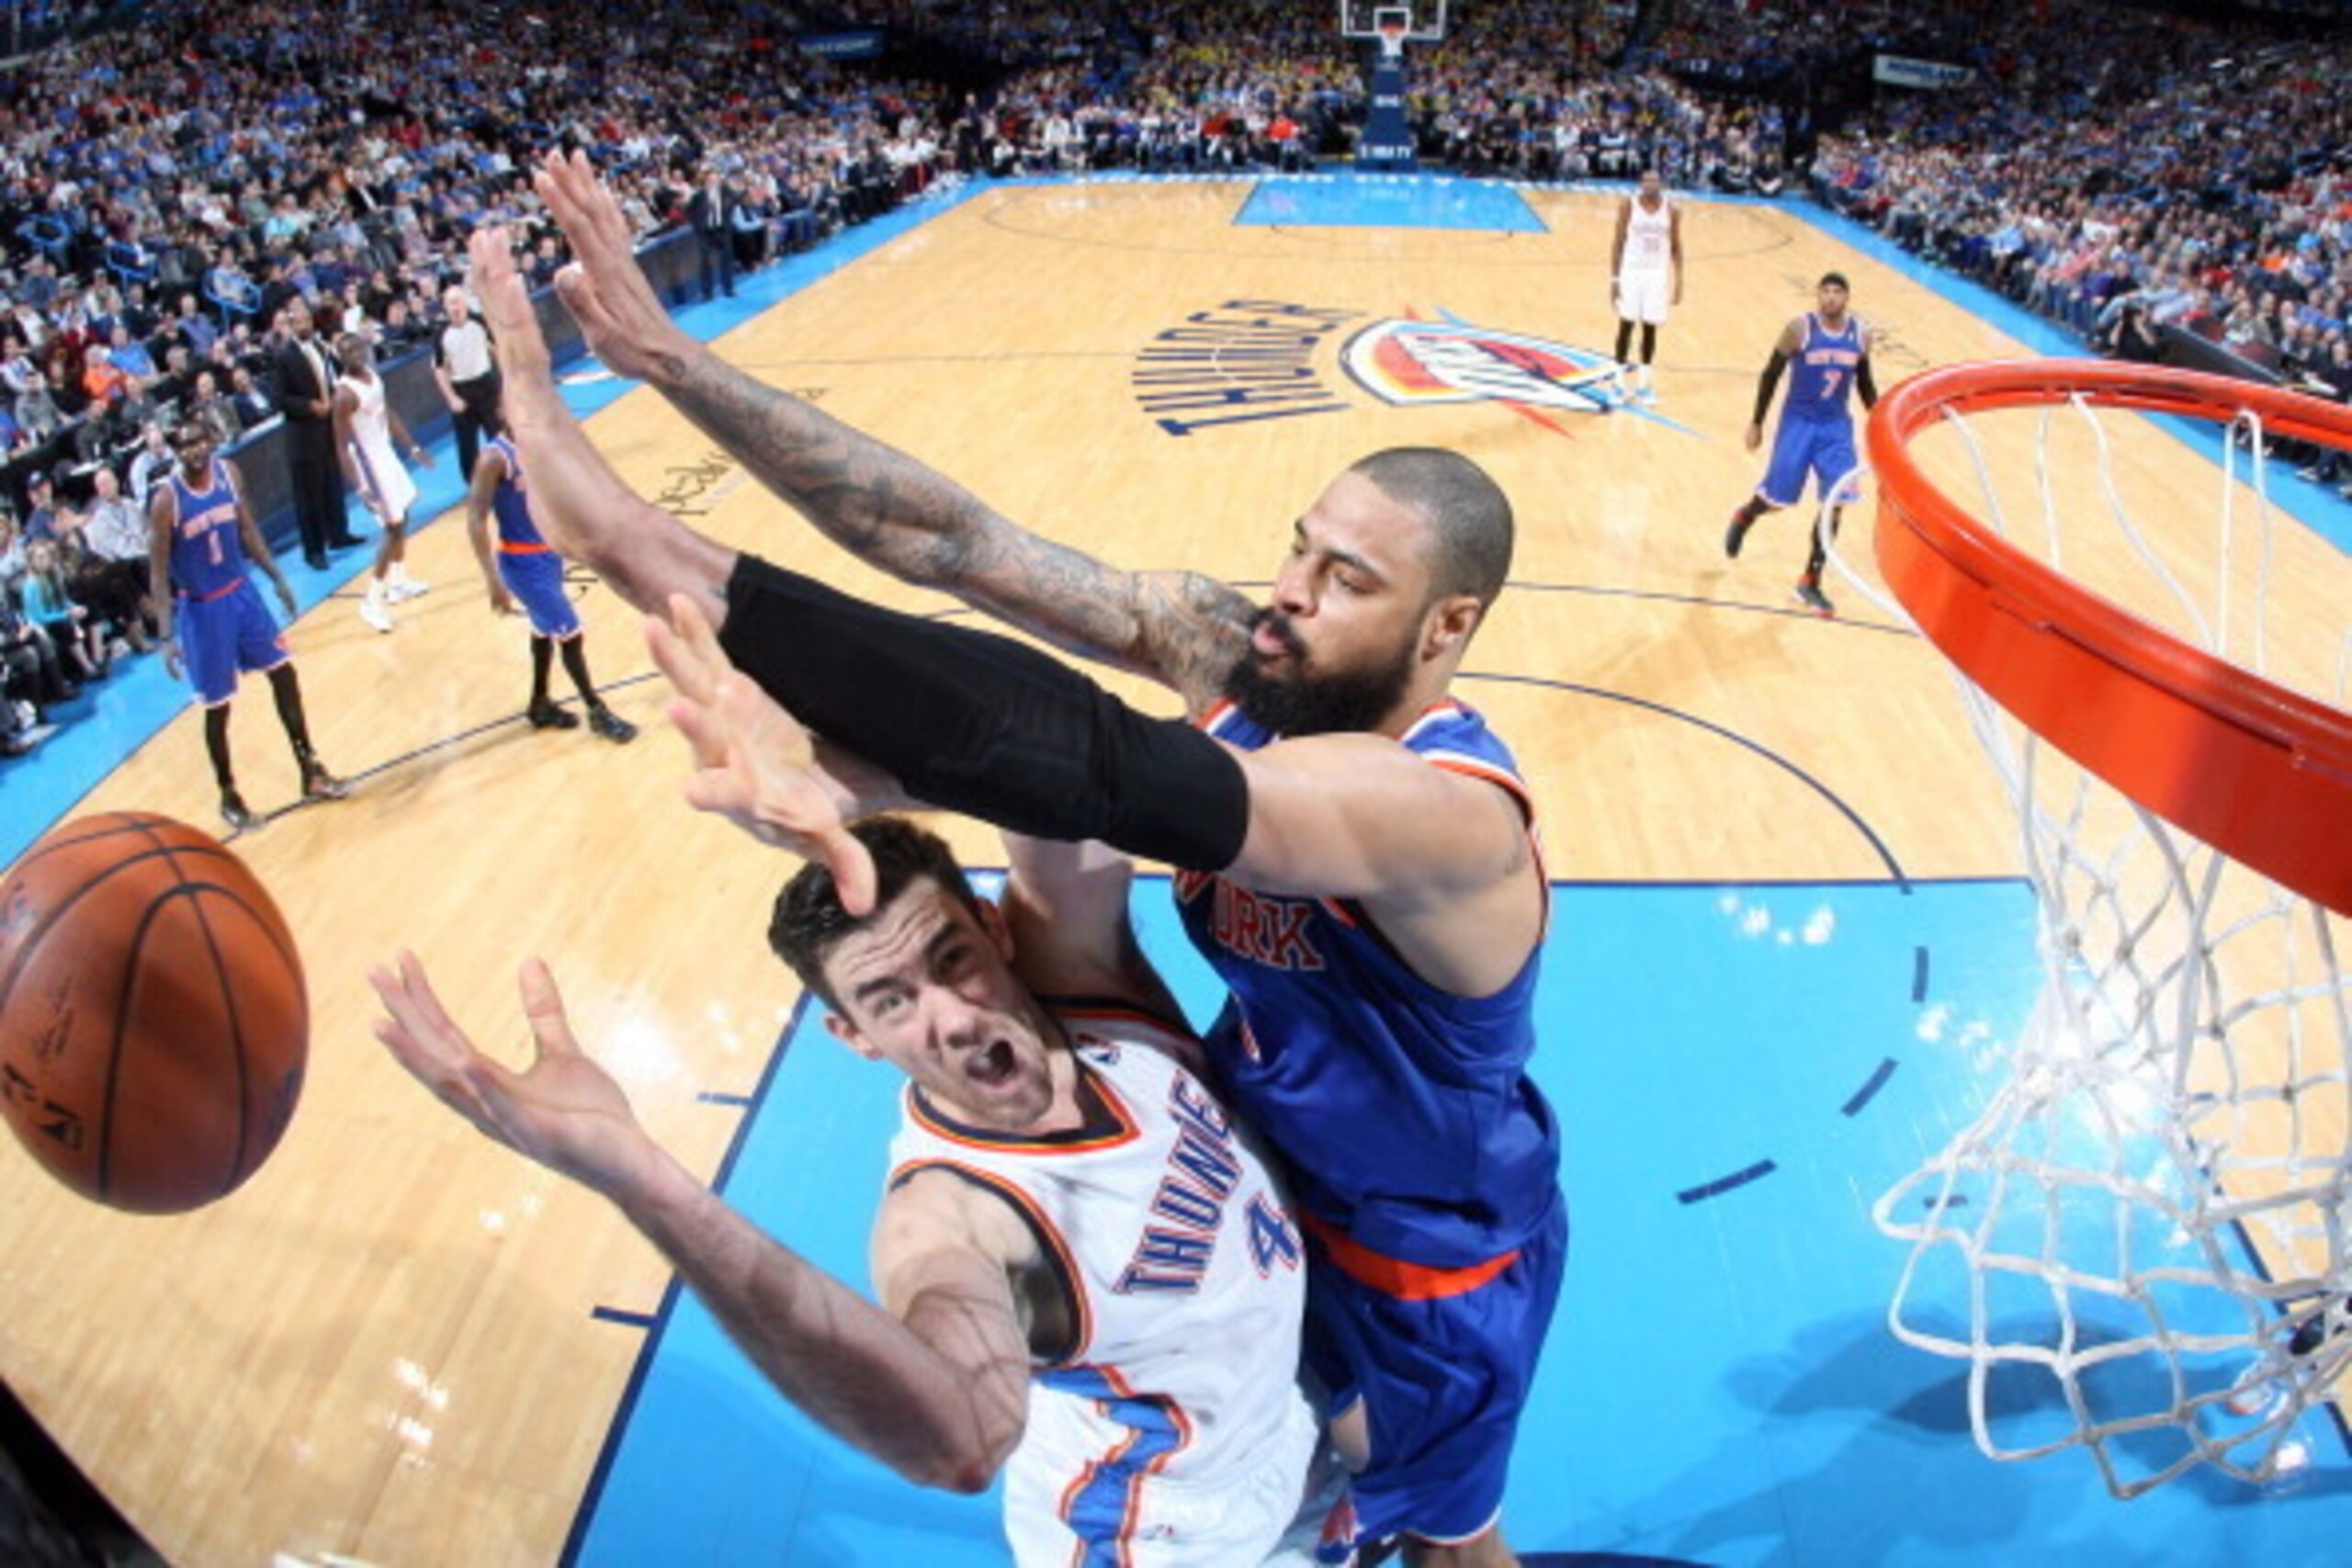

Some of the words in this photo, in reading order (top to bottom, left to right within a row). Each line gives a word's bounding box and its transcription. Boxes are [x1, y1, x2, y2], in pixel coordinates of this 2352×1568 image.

[1131, 300, 1369, 436] THUNDER
[1821, 370, 1842, 398] 7
[209, 530, 223, 565] 1
[1244, 1191, 1299, 1280] 4
